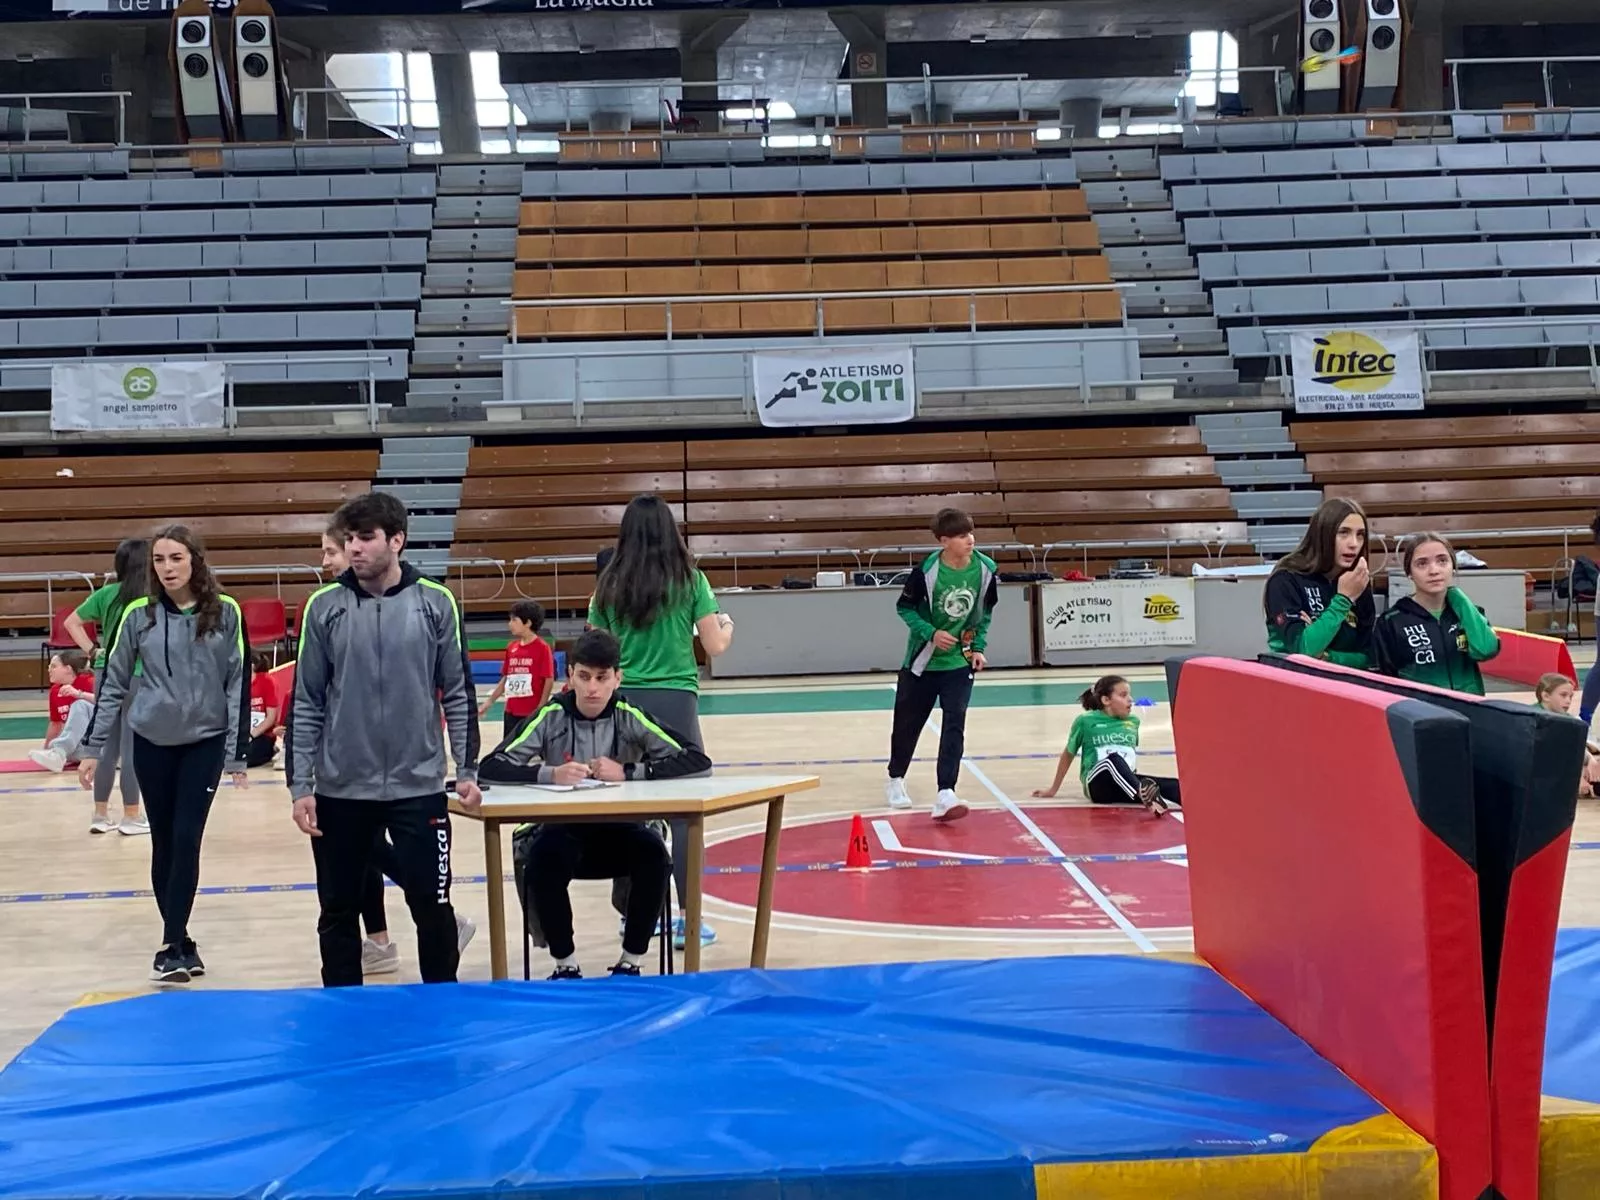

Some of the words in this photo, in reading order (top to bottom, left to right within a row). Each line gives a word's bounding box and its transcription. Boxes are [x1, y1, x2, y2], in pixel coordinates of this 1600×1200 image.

[820, 364, 904, 378] ATLETISMO
[821, 377, 905, 404] ZOITI
[103, 403, 129, 413] angel
[132, 403, 178, 413] sampietro
[1046, 606, 1065, 625] CLUB
[1066, 597, 1112, 610] ATLETISMO
[1080, 613, 1111, 624] ZOITI
[508, 681, 526, 691] 597
[853, 835, 869, 852] 15
